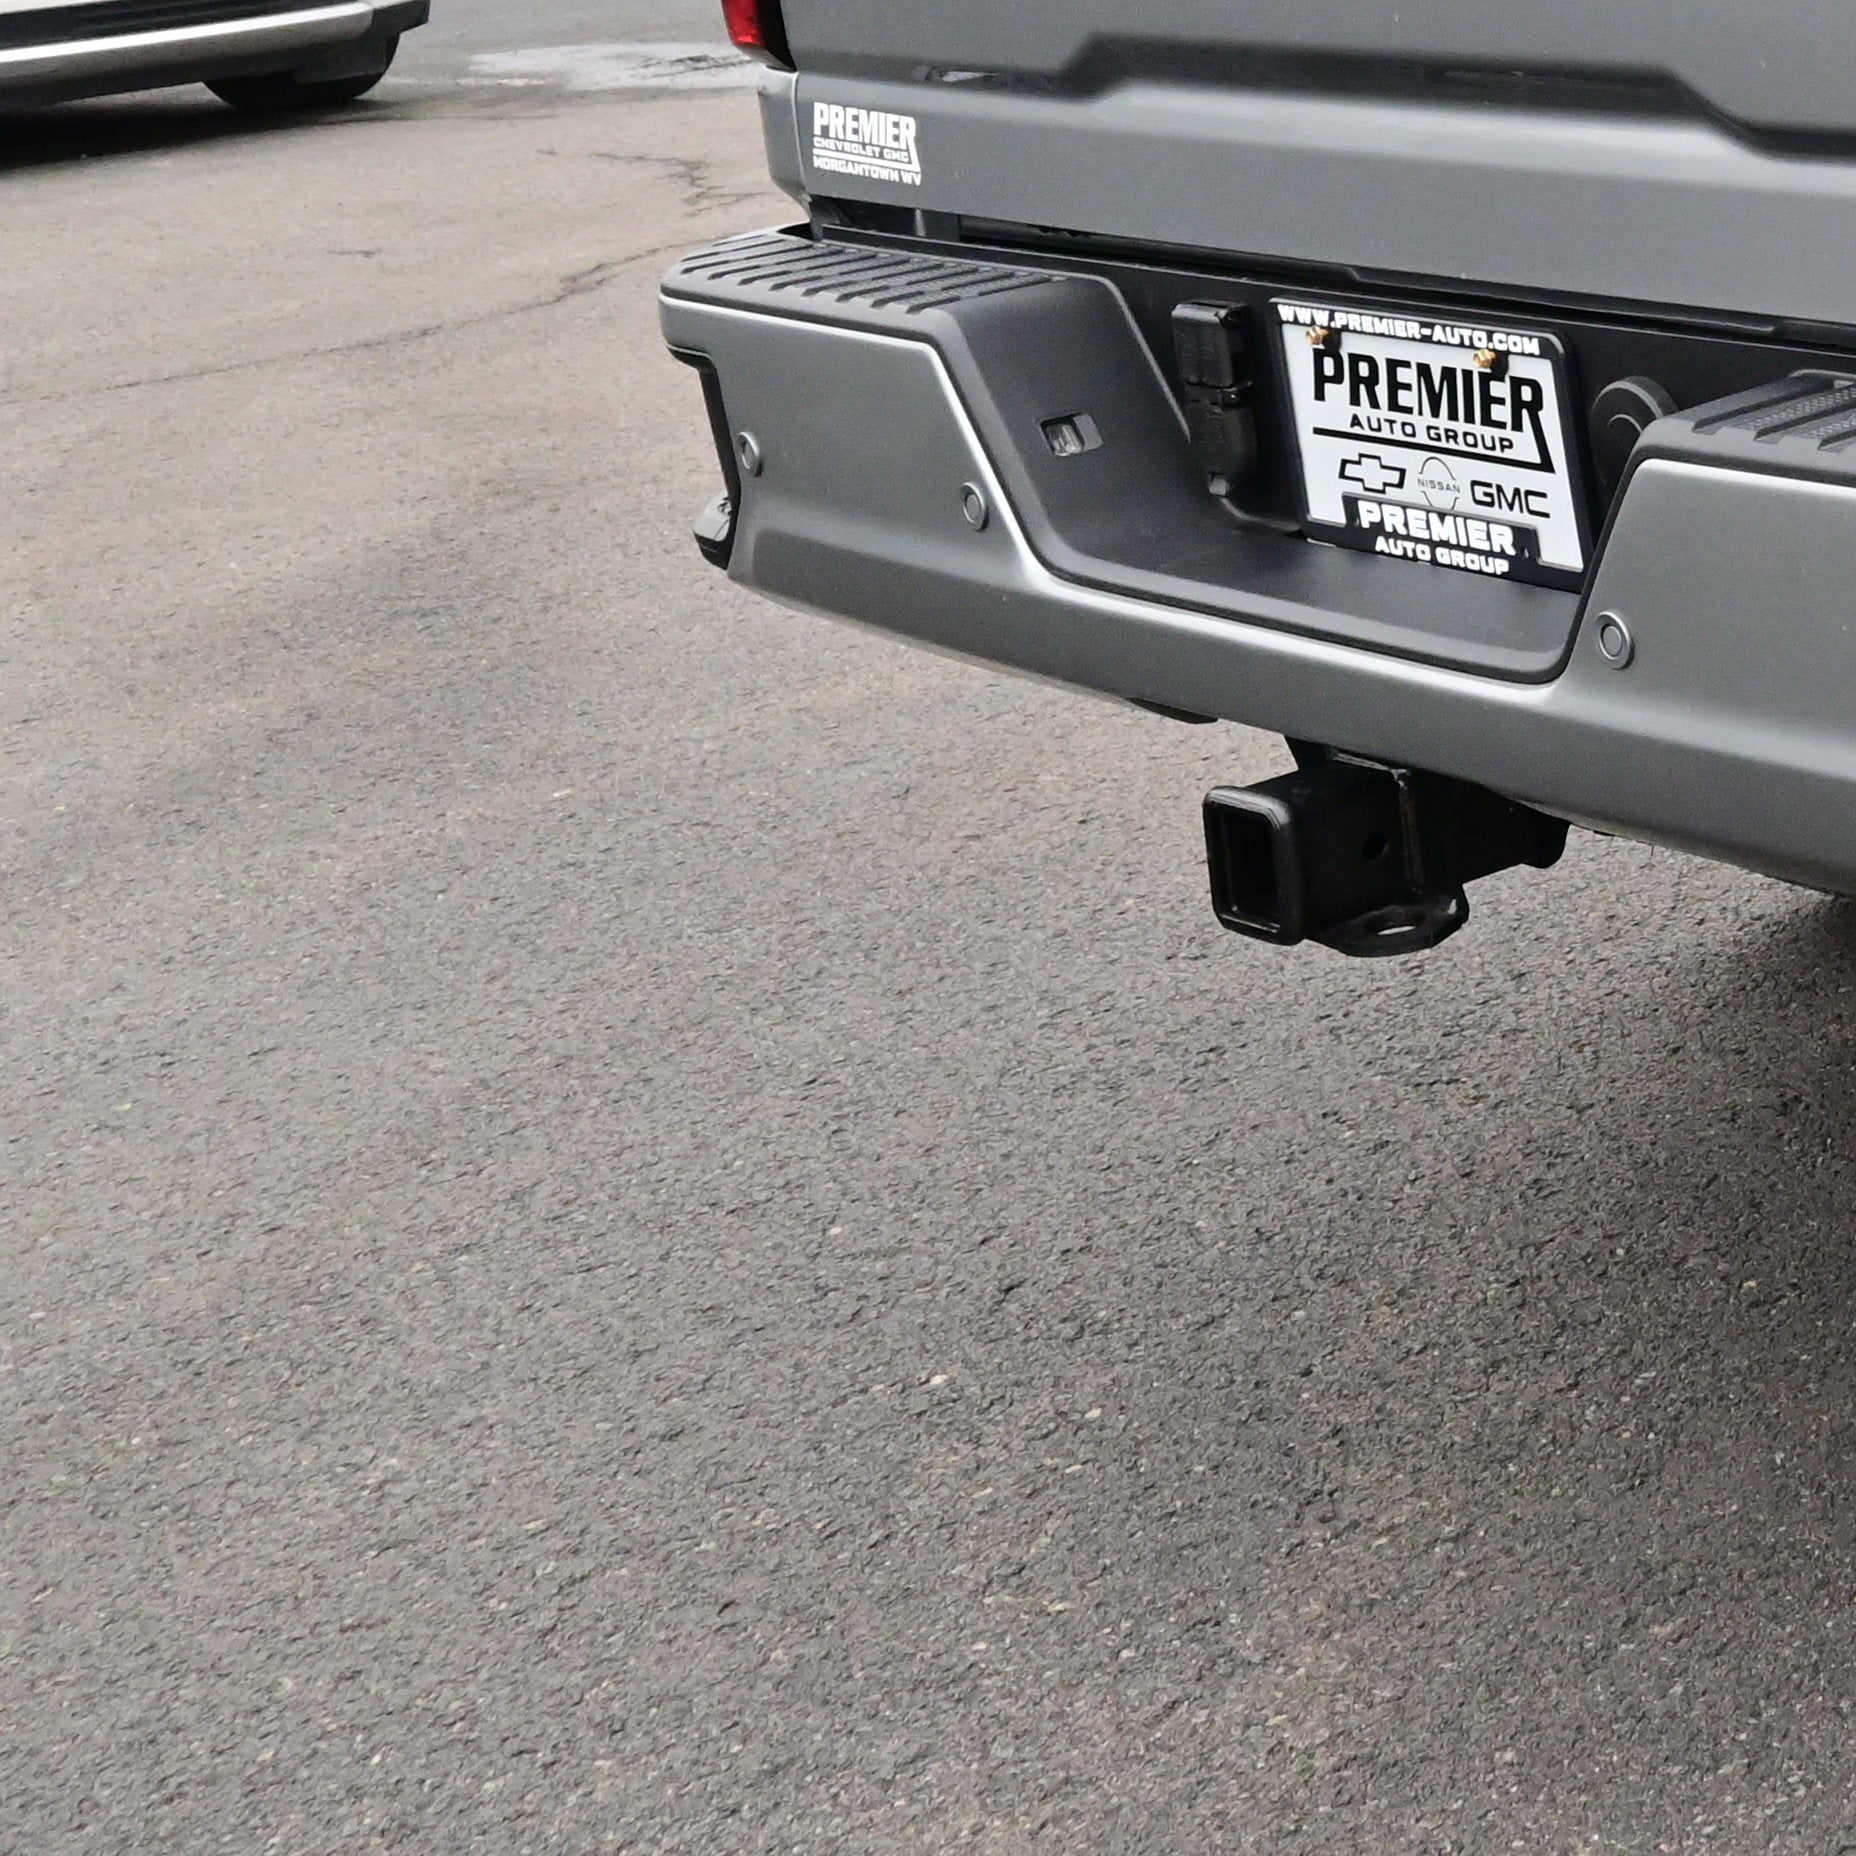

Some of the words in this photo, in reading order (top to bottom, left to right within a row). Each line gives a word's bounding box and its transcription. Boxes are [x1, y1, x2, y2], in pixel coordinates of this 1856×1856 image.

[813, 101, 918, 152] PREMIER
[813, 136, 881, 158] CHEVROLET
[883, 147, 909, 163] GMC
[813, 155, 900, 183] MORGANTOWN
[901, 170, 922, 186] WV
[1276, 303, 1541, 356] WWW.PREMIER-AUTO.COM
[1312, 347, 1549, 440] PREMIER
[1348, 412, 1417, 439] AUTO
[1425, 424, 1515, 454] GROUP
[1416, 476, 1461, 495] NISSAN
[1470, 479, 1552, 519] GMC
[1356, 500, 1517, 557] PREMIER
[1374, 535, 1432, 562] AUTO
[1434, 546, 1511, 576] GROUP
